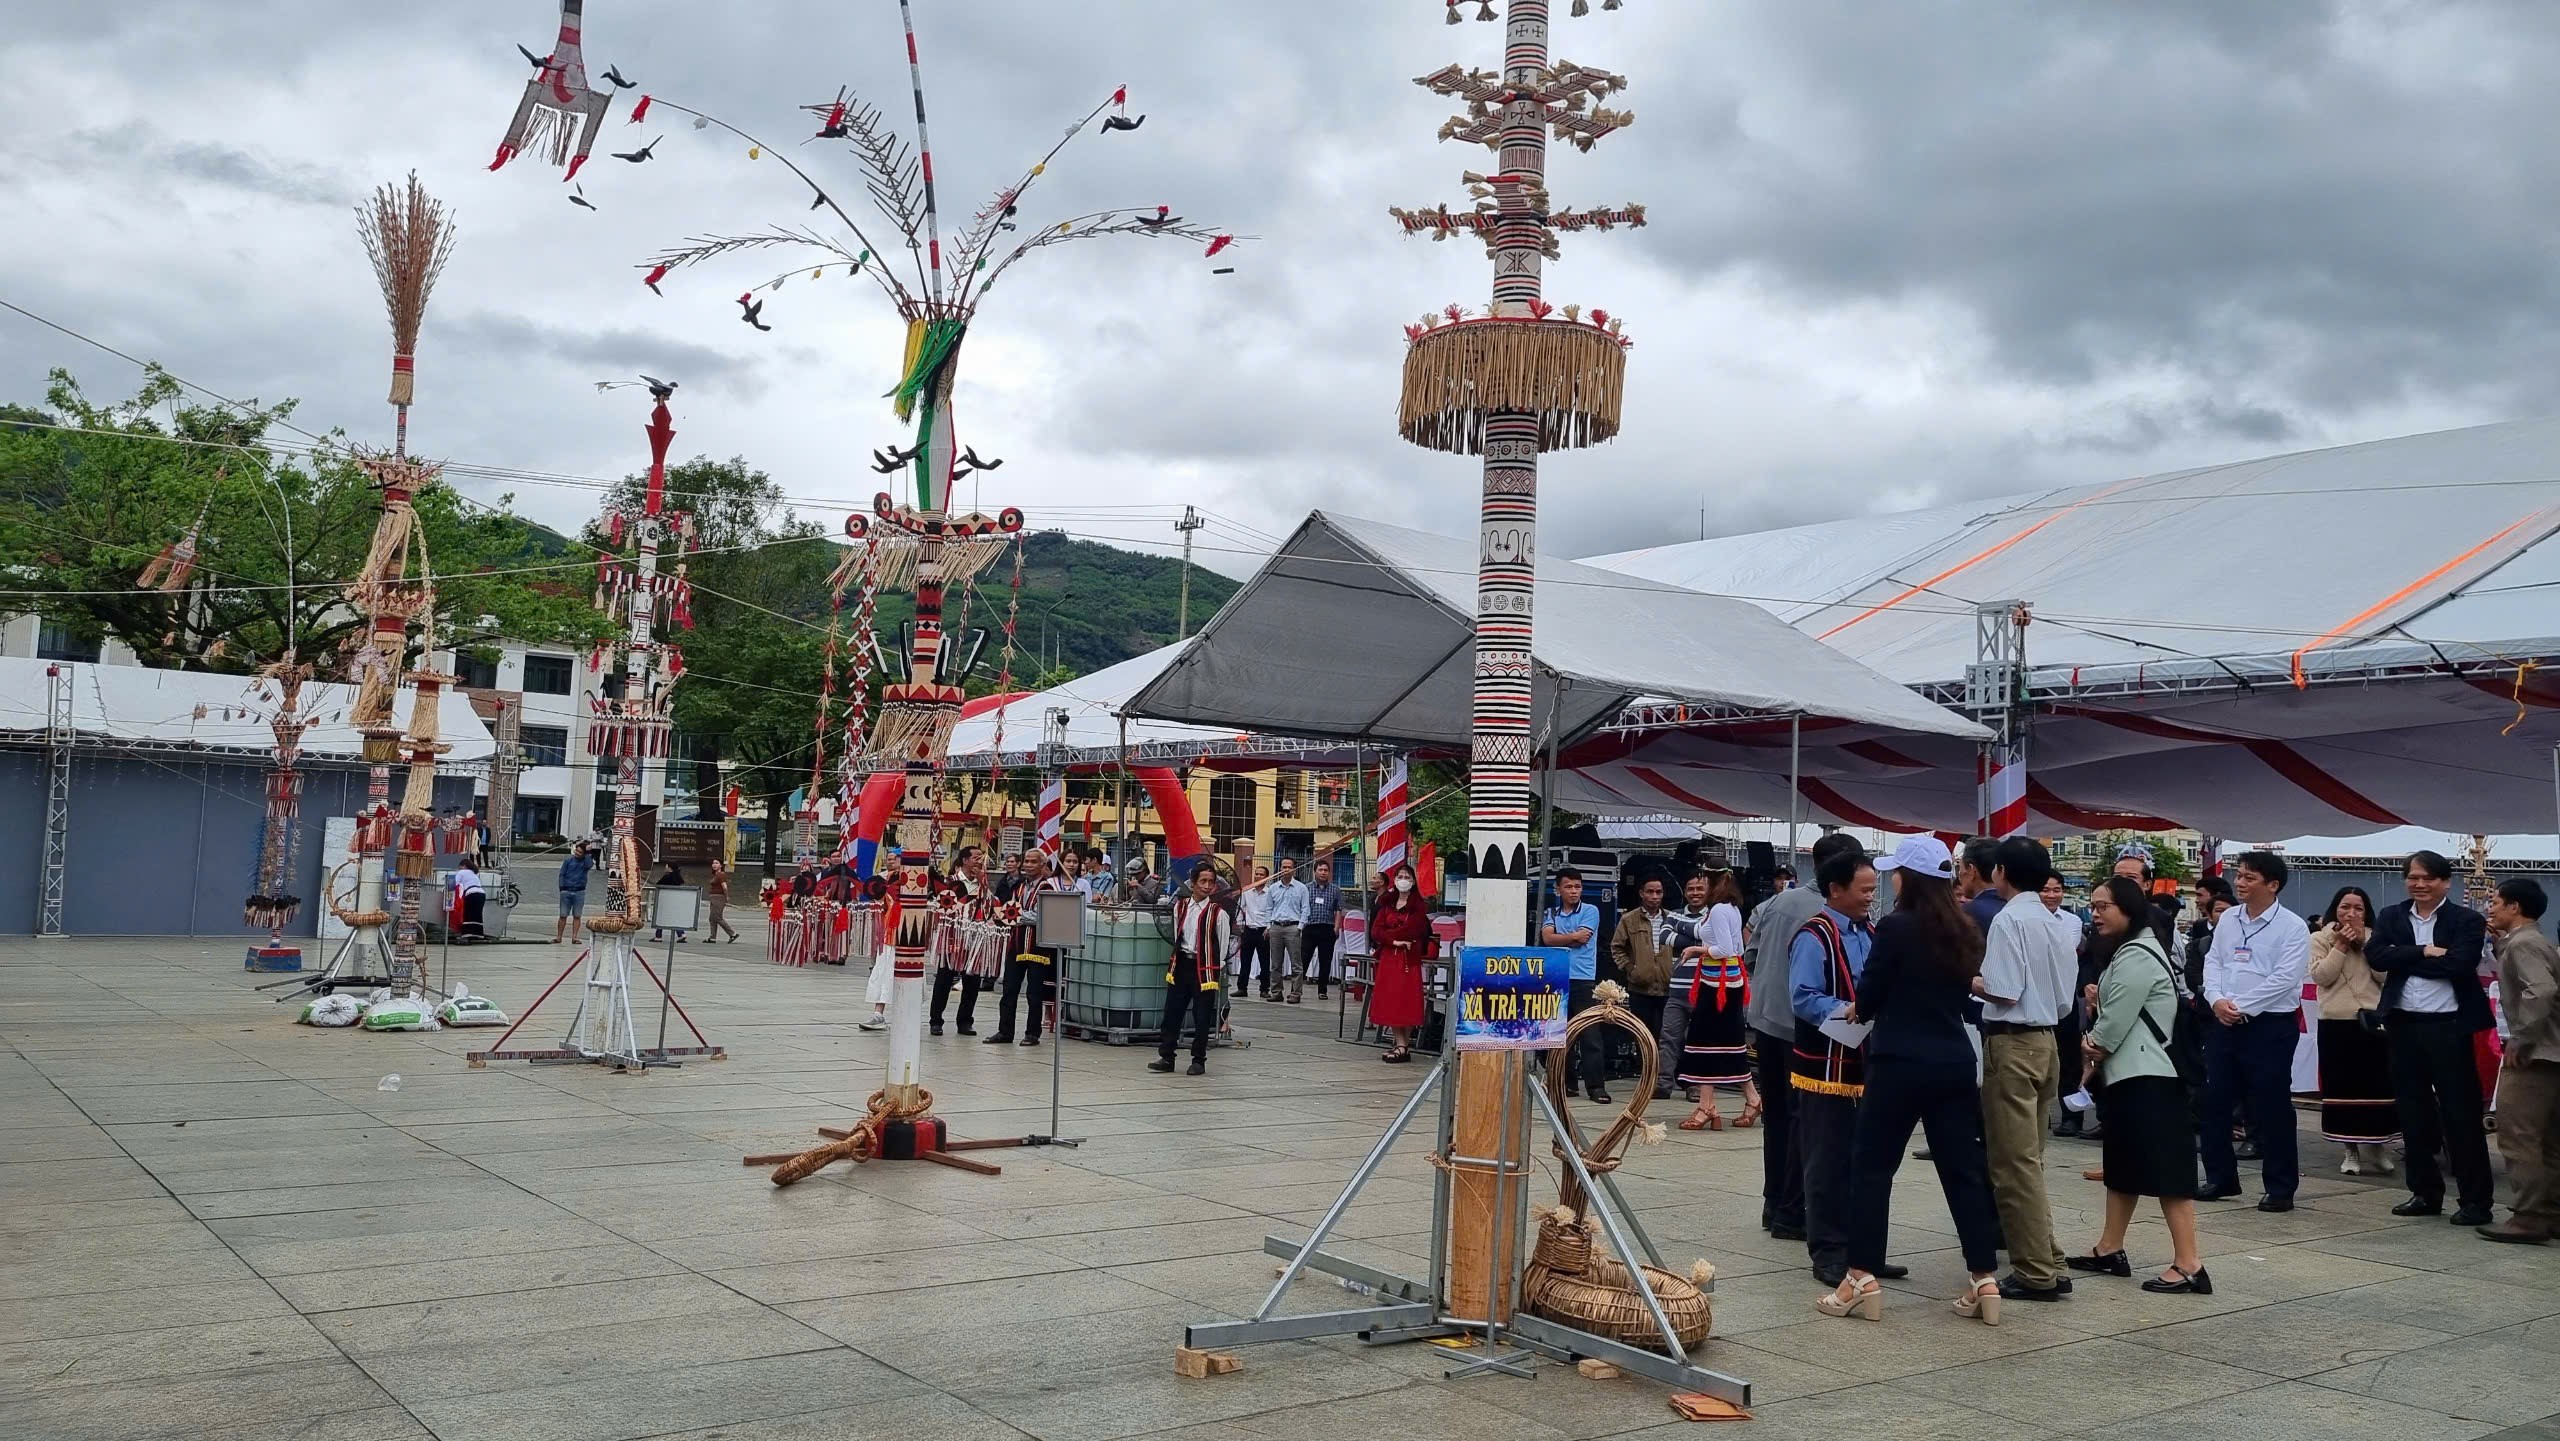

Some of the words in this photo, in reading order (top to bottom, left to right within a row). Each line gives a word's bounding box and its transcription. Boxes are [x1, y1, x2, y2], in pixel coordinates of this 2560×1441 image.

[1486, 956, 1520, 975] ĐƠN
[1526, 958, 1544, 979] VỊ
[1463, 987, 1484, 1020] XÃ
[1489, 987, 1517, 1020] TRÀ
[1522, 984, 1561, 1020] THỦY
